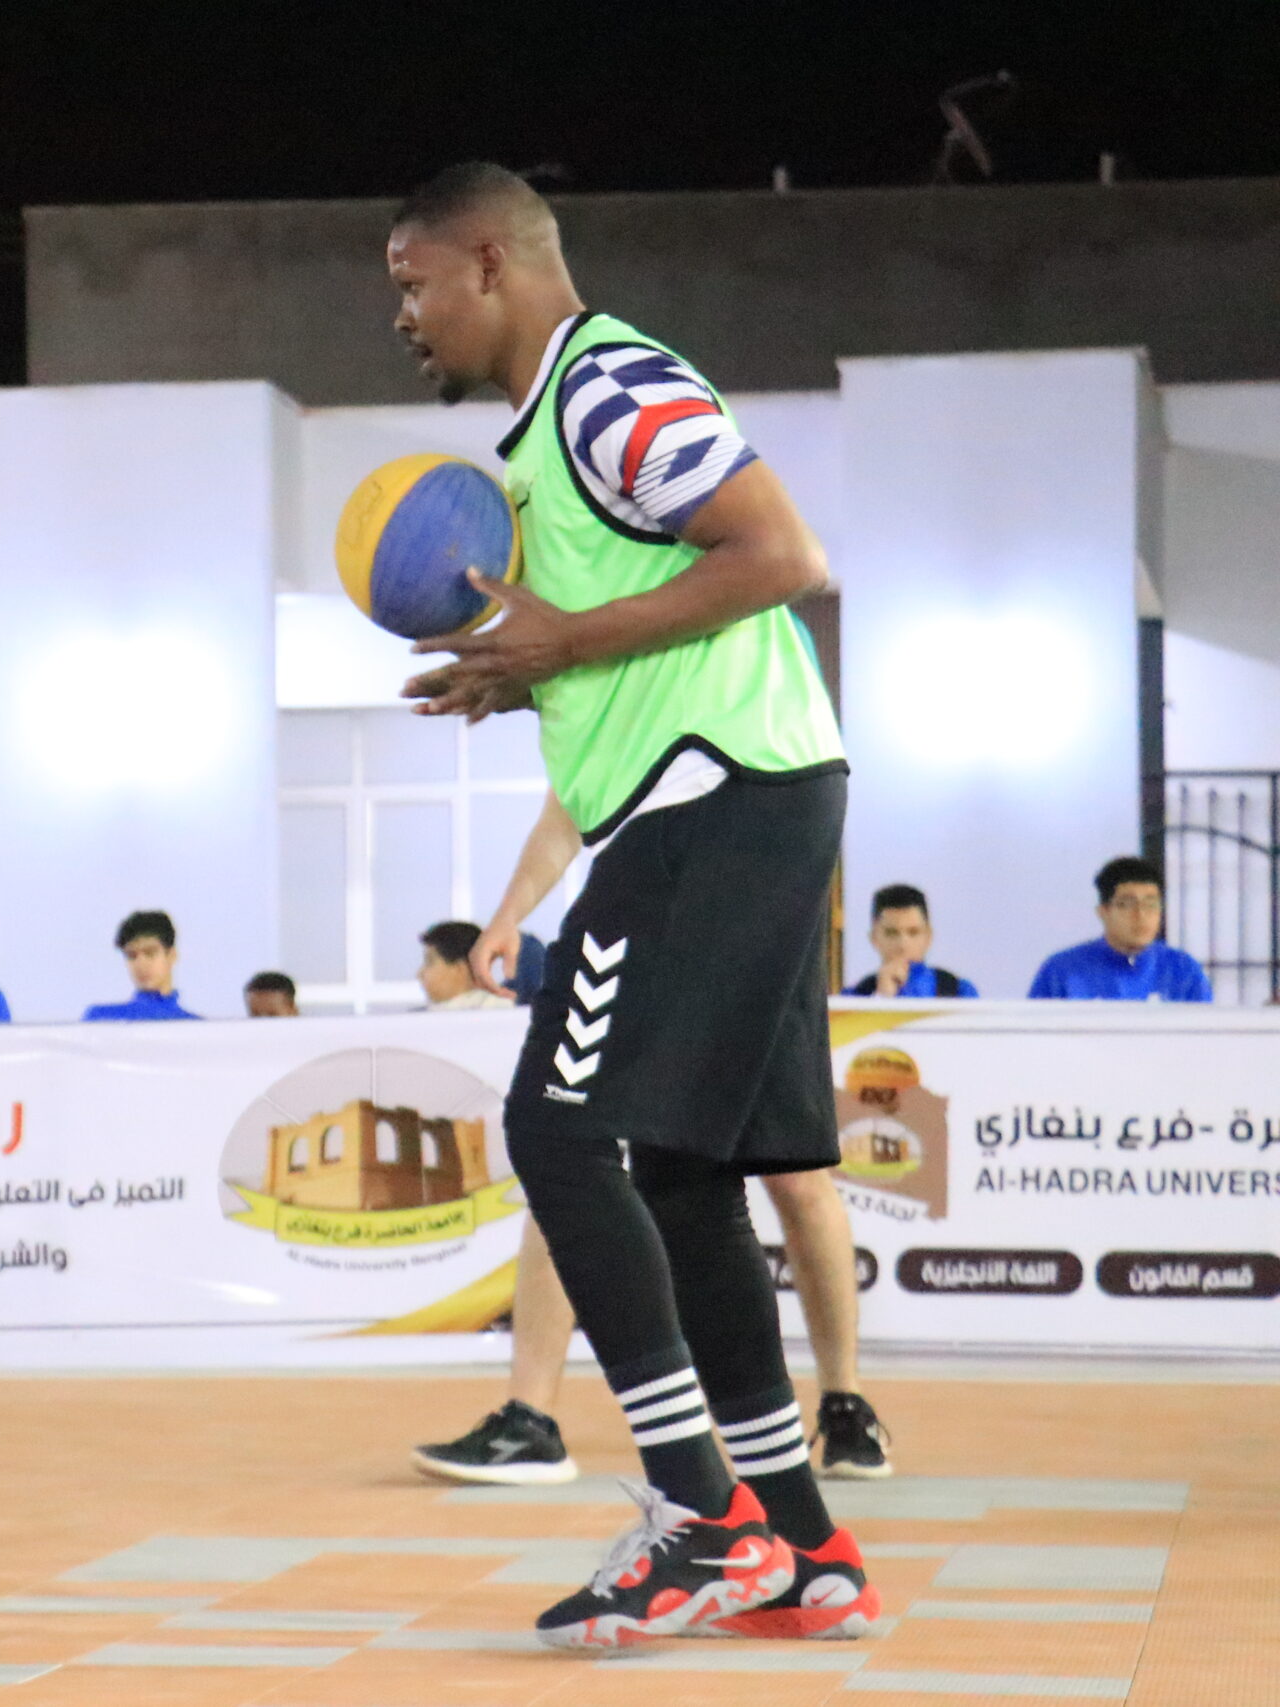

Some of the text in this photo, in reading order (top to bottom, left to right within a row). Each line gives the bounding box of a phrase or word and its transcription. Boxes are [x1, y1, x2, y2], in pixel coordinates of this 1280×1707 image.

[975, 1106, 1102, 1158] بنغازي
[114, 1176, 186, 1208] التميز
[1146, 1168, 1280, 1196] UNIVER
